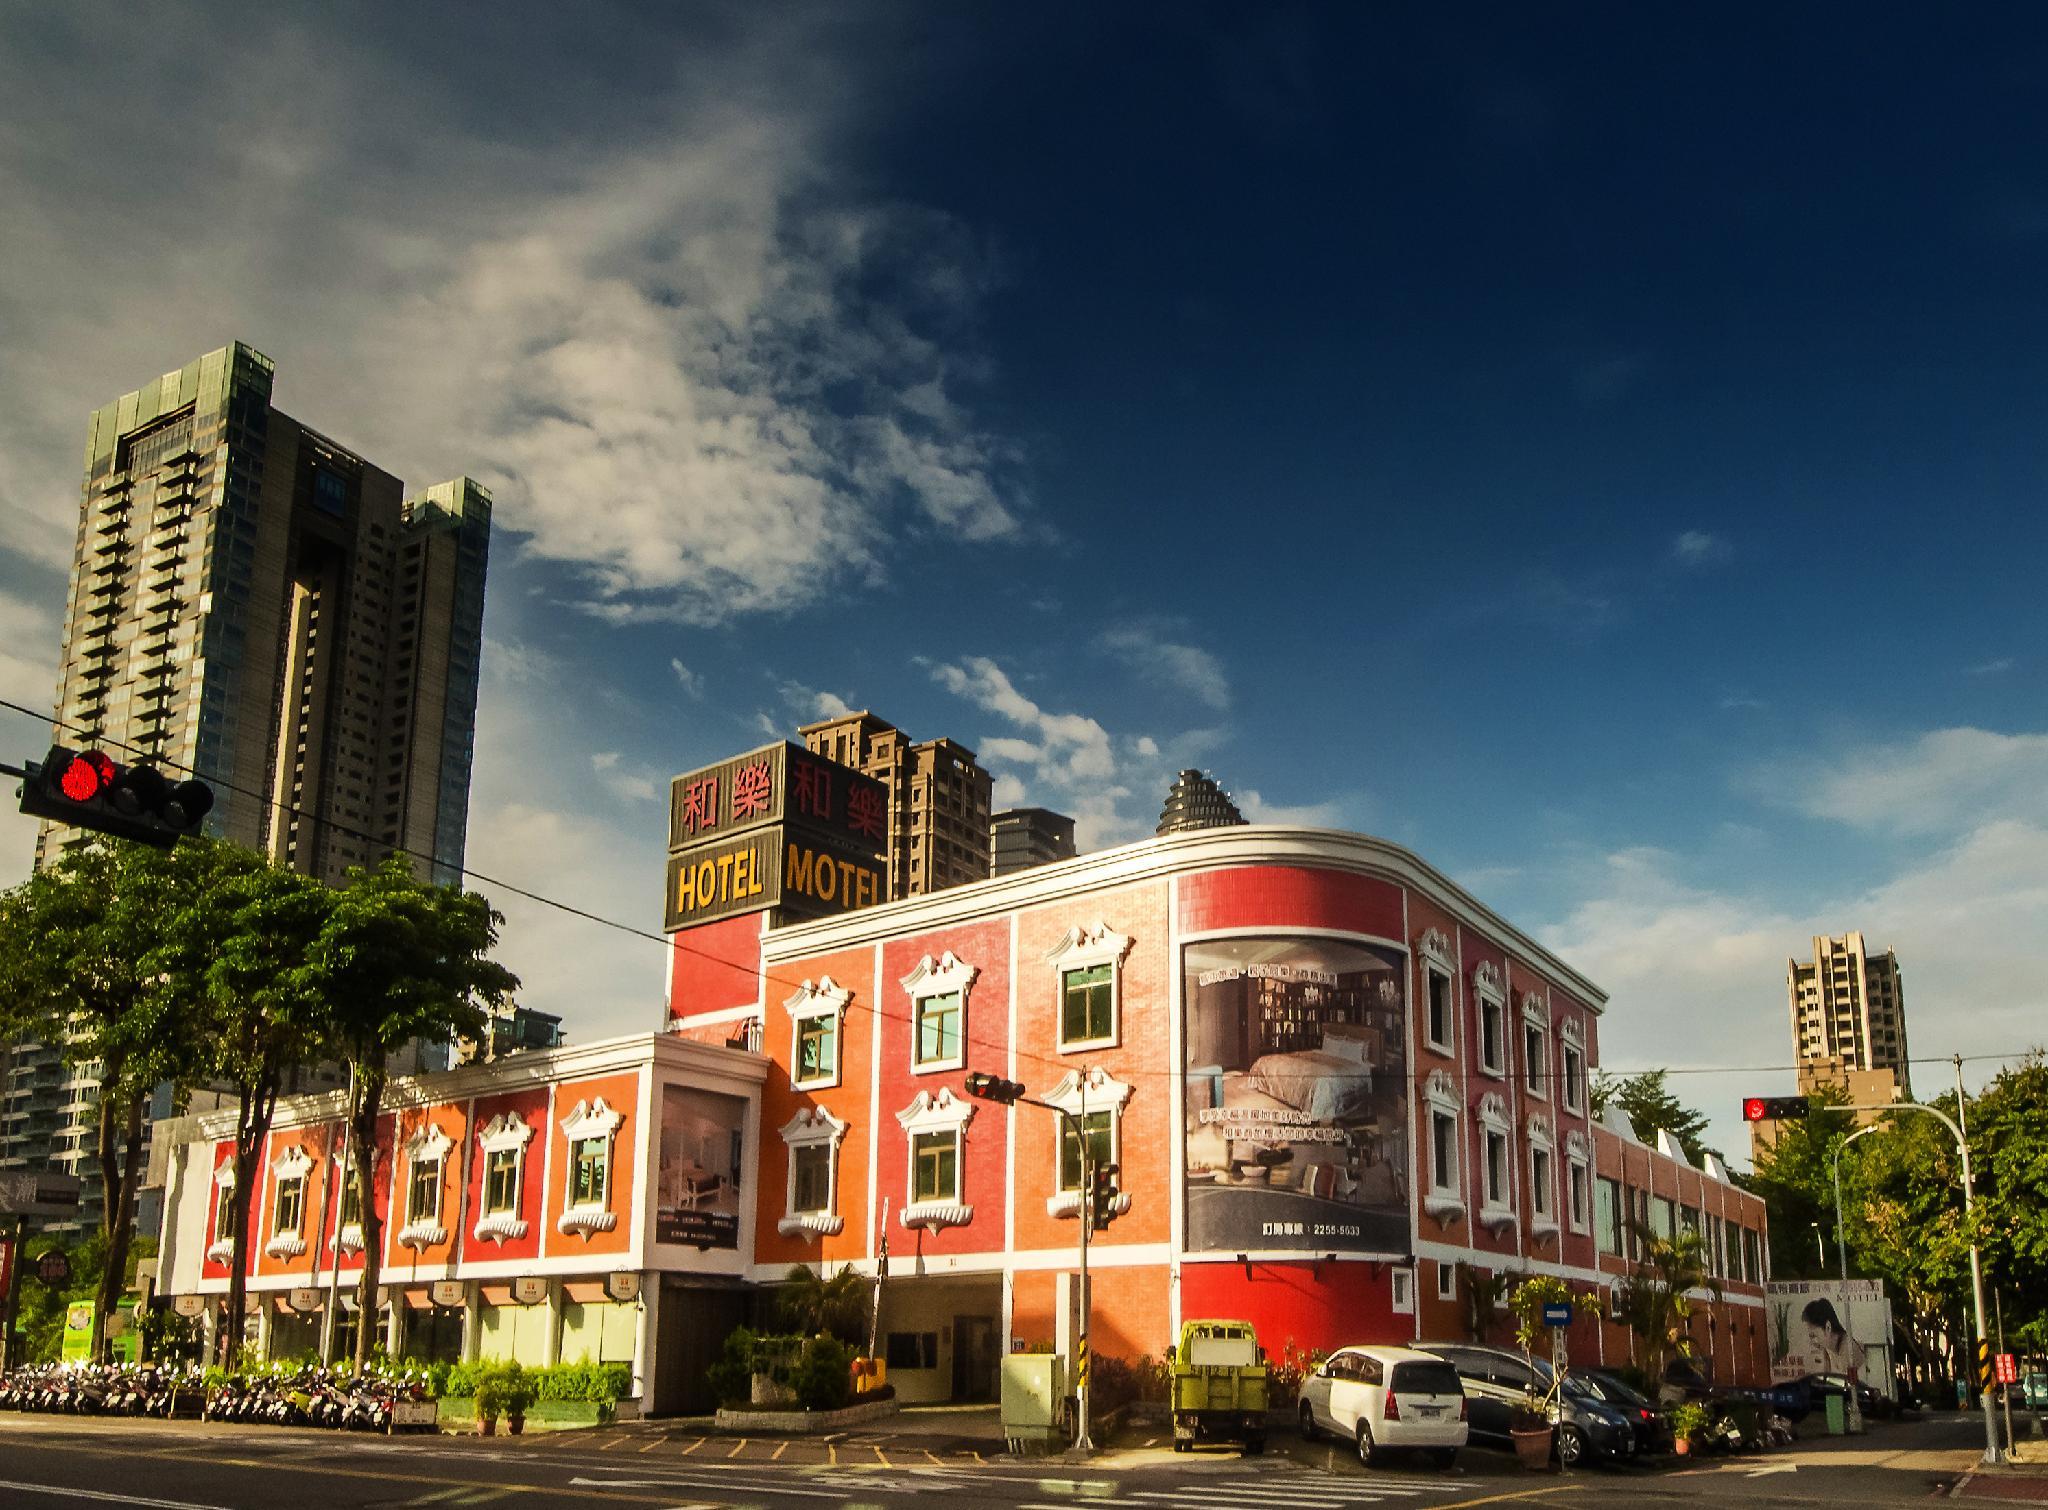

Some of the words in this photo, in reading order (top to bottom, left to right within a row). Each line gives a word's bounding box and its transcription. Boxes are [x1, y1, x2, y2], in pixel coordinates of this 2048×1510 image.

[682, 759, 772, 834] 和樂
[793, 761, 883, 839] 和樂
[677, 847, 763, 913] HOTEL
[786, 842, 878, 909] MOTEL
